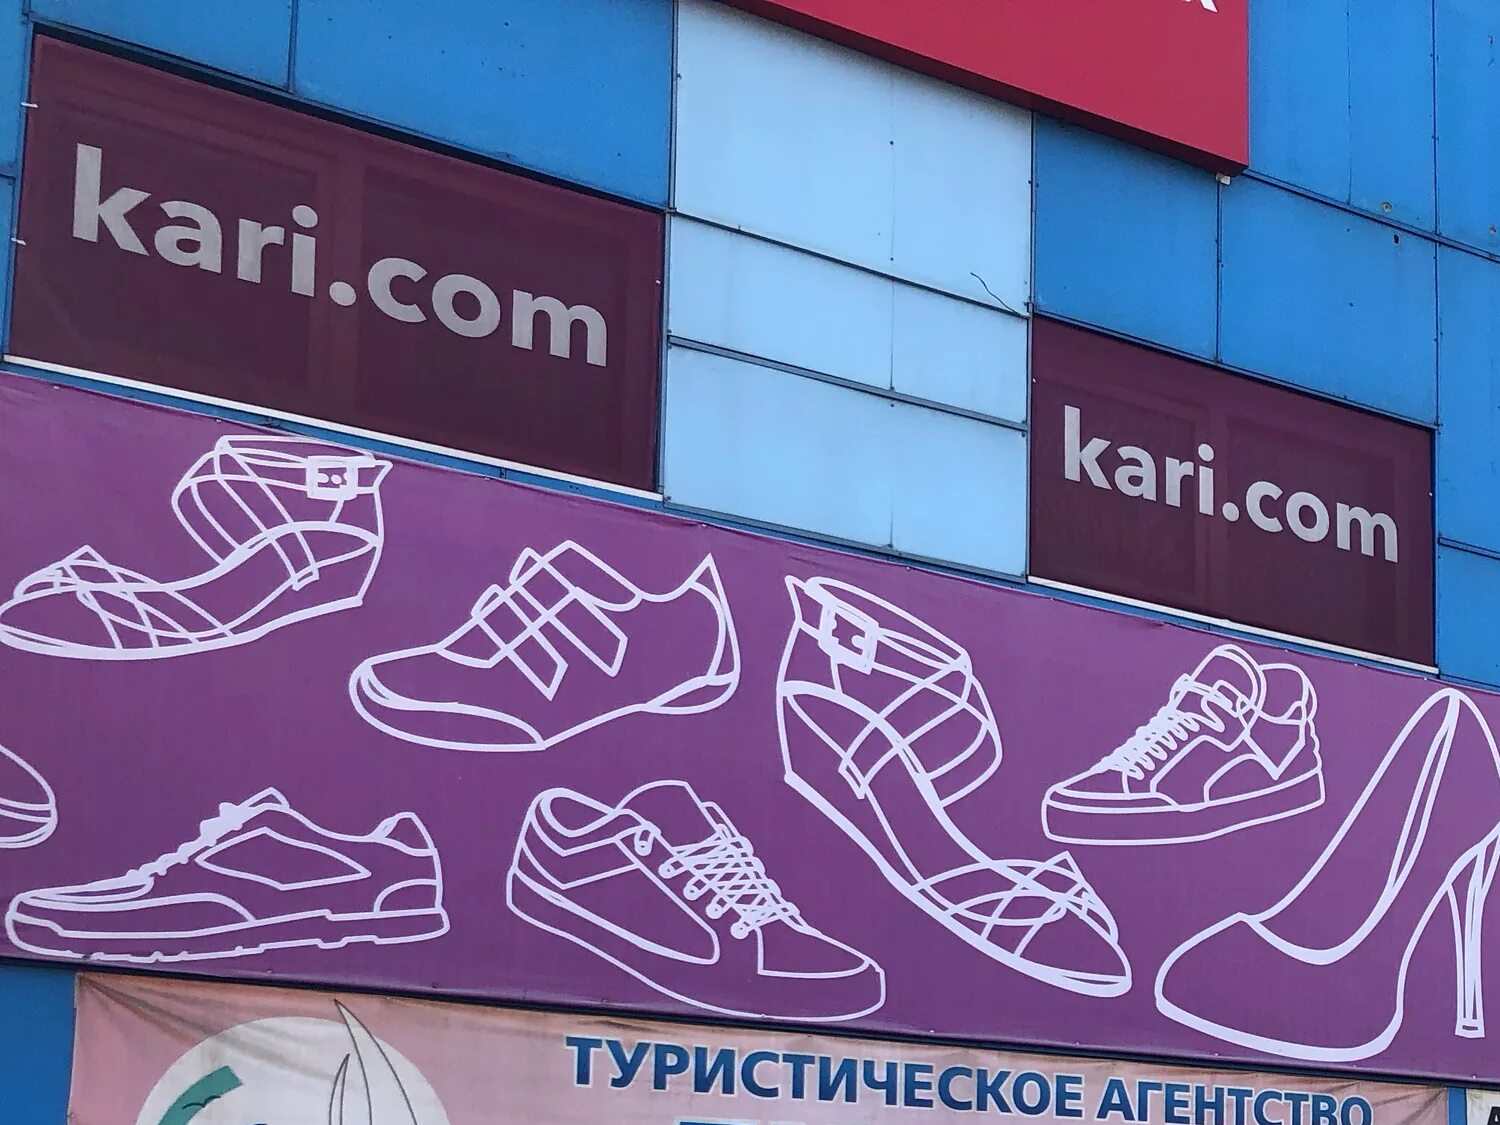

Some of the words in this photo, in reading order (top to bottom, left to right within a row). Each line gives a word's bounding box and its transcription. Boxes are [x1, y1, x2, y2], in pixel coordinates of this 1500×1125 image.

[72, 143, 608, 367] kari.com
[1063, 405, 1398, 563] kari.com
[567, 1037, 1084, 1118] ТУРИСТИЧЕСКОЕ
